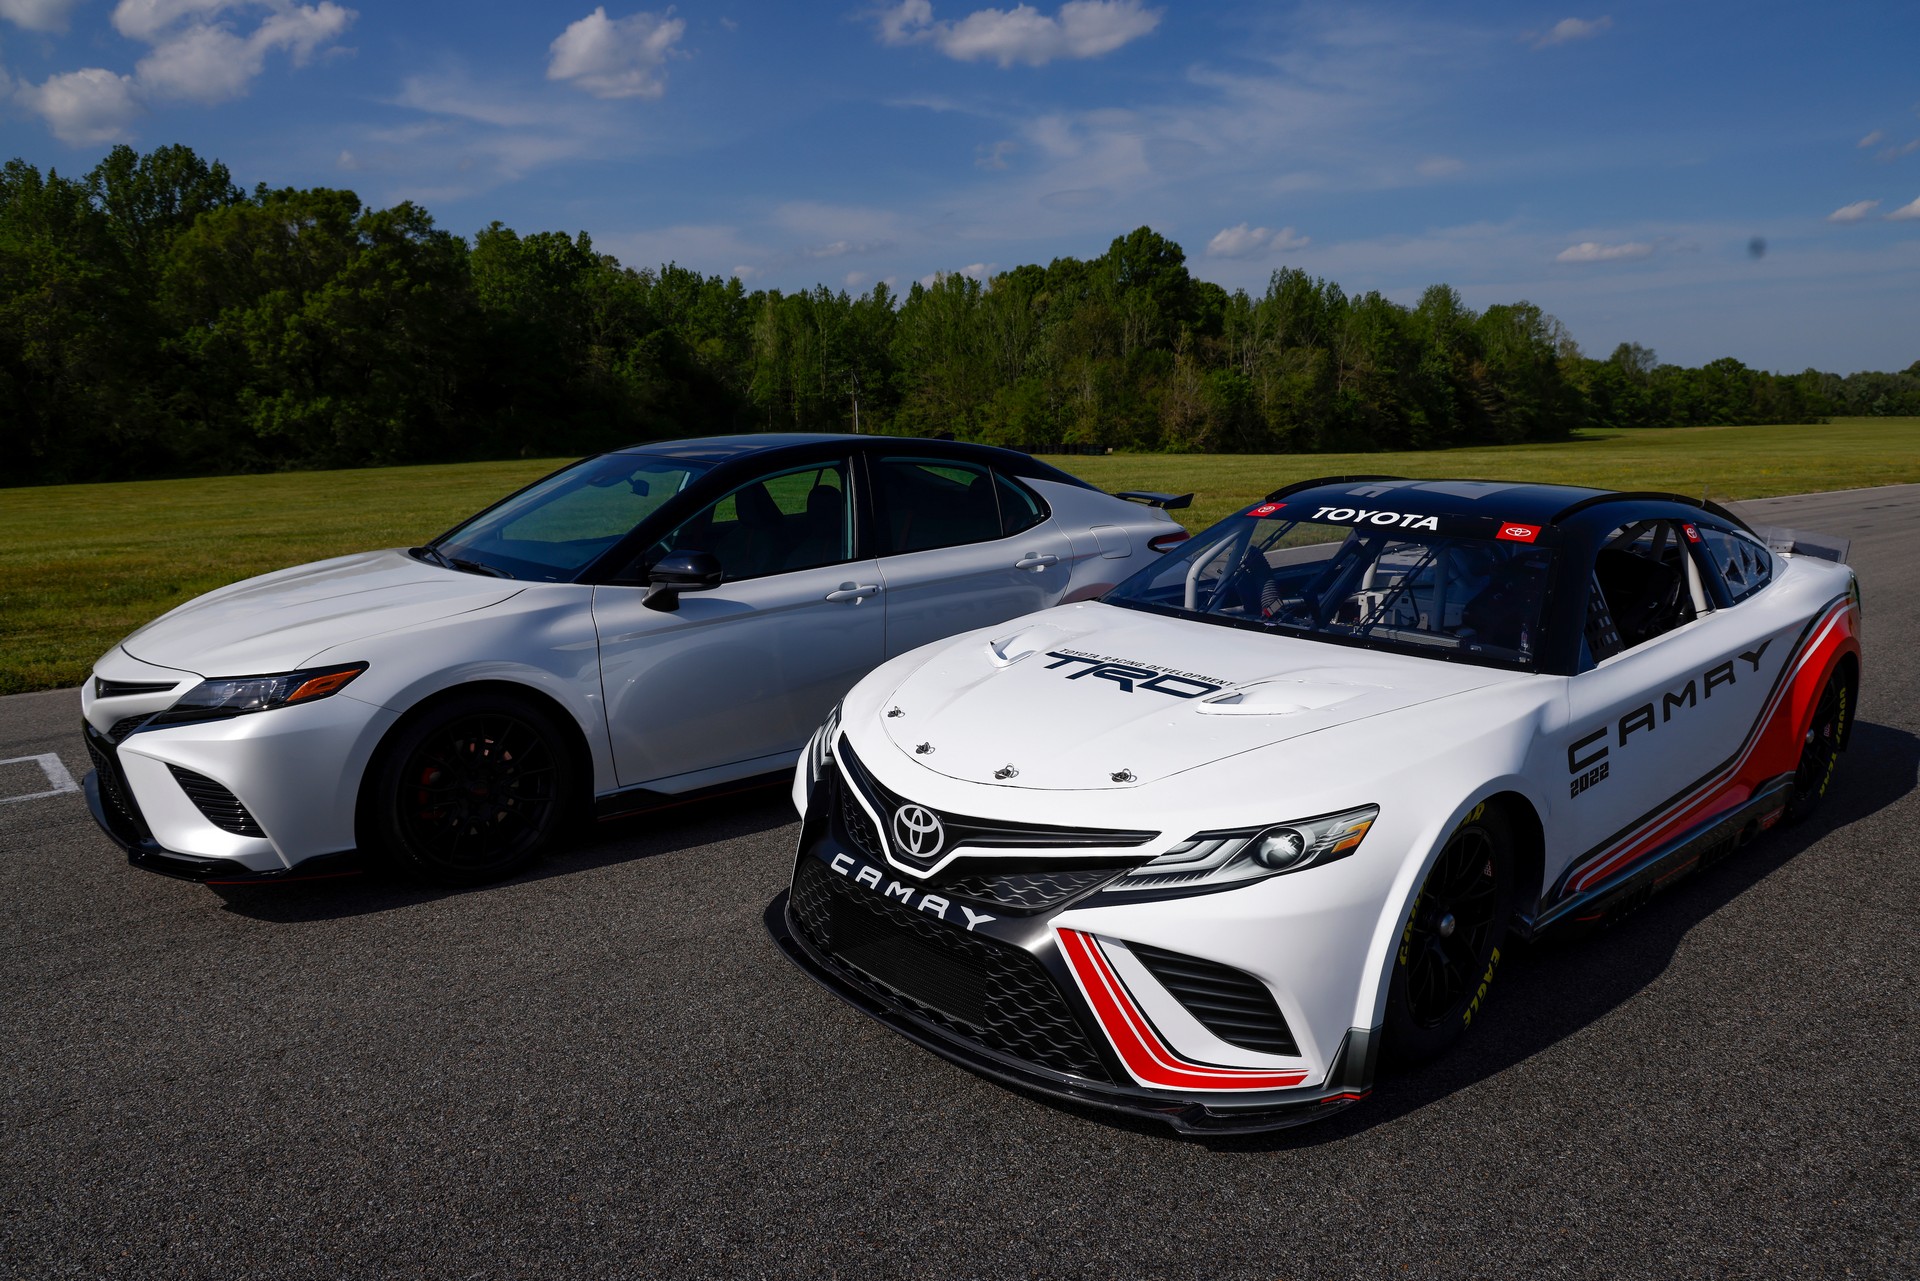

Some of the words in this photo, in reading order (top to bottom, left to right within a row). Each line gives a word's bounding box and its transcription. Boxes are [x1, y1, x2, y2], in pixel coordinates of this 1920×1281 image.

[1312, 507, 1438, 531] TOYOTA
[1043, 651, 1222, 699] TRD
[1060, 648, 1101, 659] TOYOTA
[1101, 656, 1145, 668] RACING
[1146, 665, 1235, 687] DEVELOPMENT
[1568, 638, 1773, 775] CAMRY
[1570, 761, 1610, 800] 2022
[830, 852, 997, 932] CAMRY
[1463, 945, 1501, 1031] EAGLE
